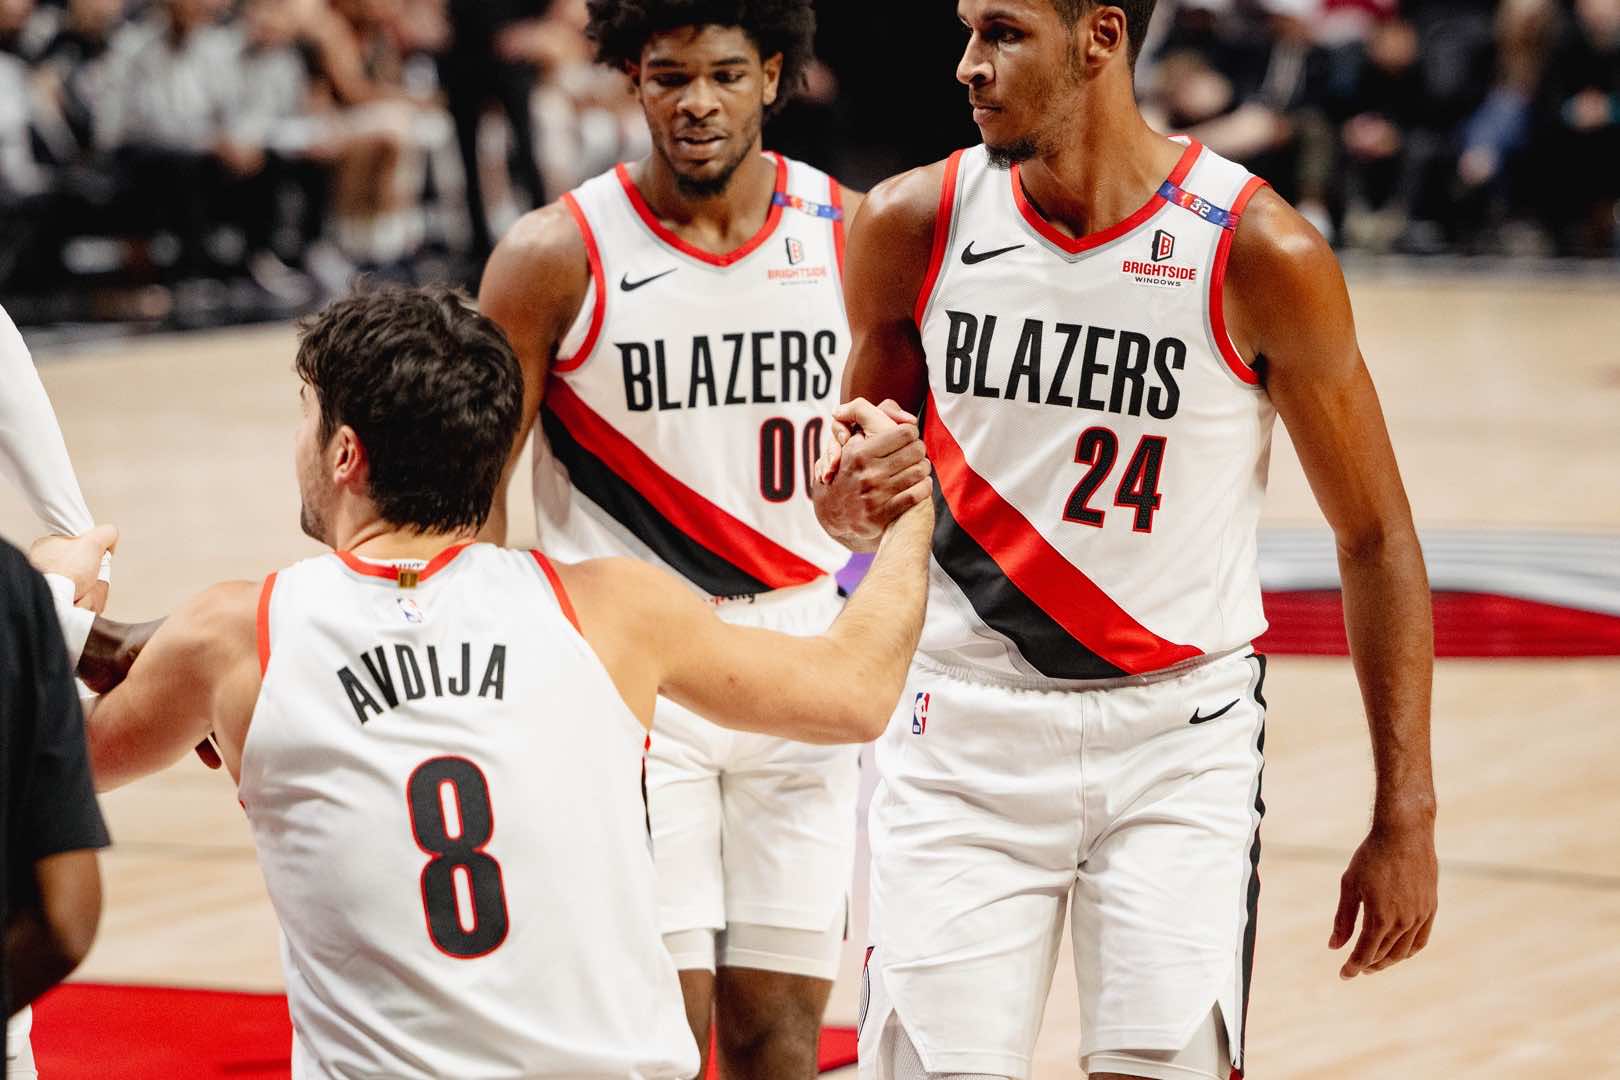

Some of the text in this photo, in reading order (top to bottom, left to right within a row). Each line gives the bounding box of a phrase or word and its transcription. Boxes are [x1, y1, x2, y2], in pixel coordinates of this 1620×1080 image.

[1160, 235, 1171, 256] B
[1190, 198, 1211, 217] 32
[1122, 260, 1197, 281] BRIGHTSIDE
[1135, 276, 1181, 287] WINDOWS
[613, 330, 836, 411] BLAZERS
[945, 310, 1187, 420] BLAZERS
[1062, 426, 1168, 533] 24
[337, 642, 506, 725] AVDIJA
[406, 756, 510, 960] 8
